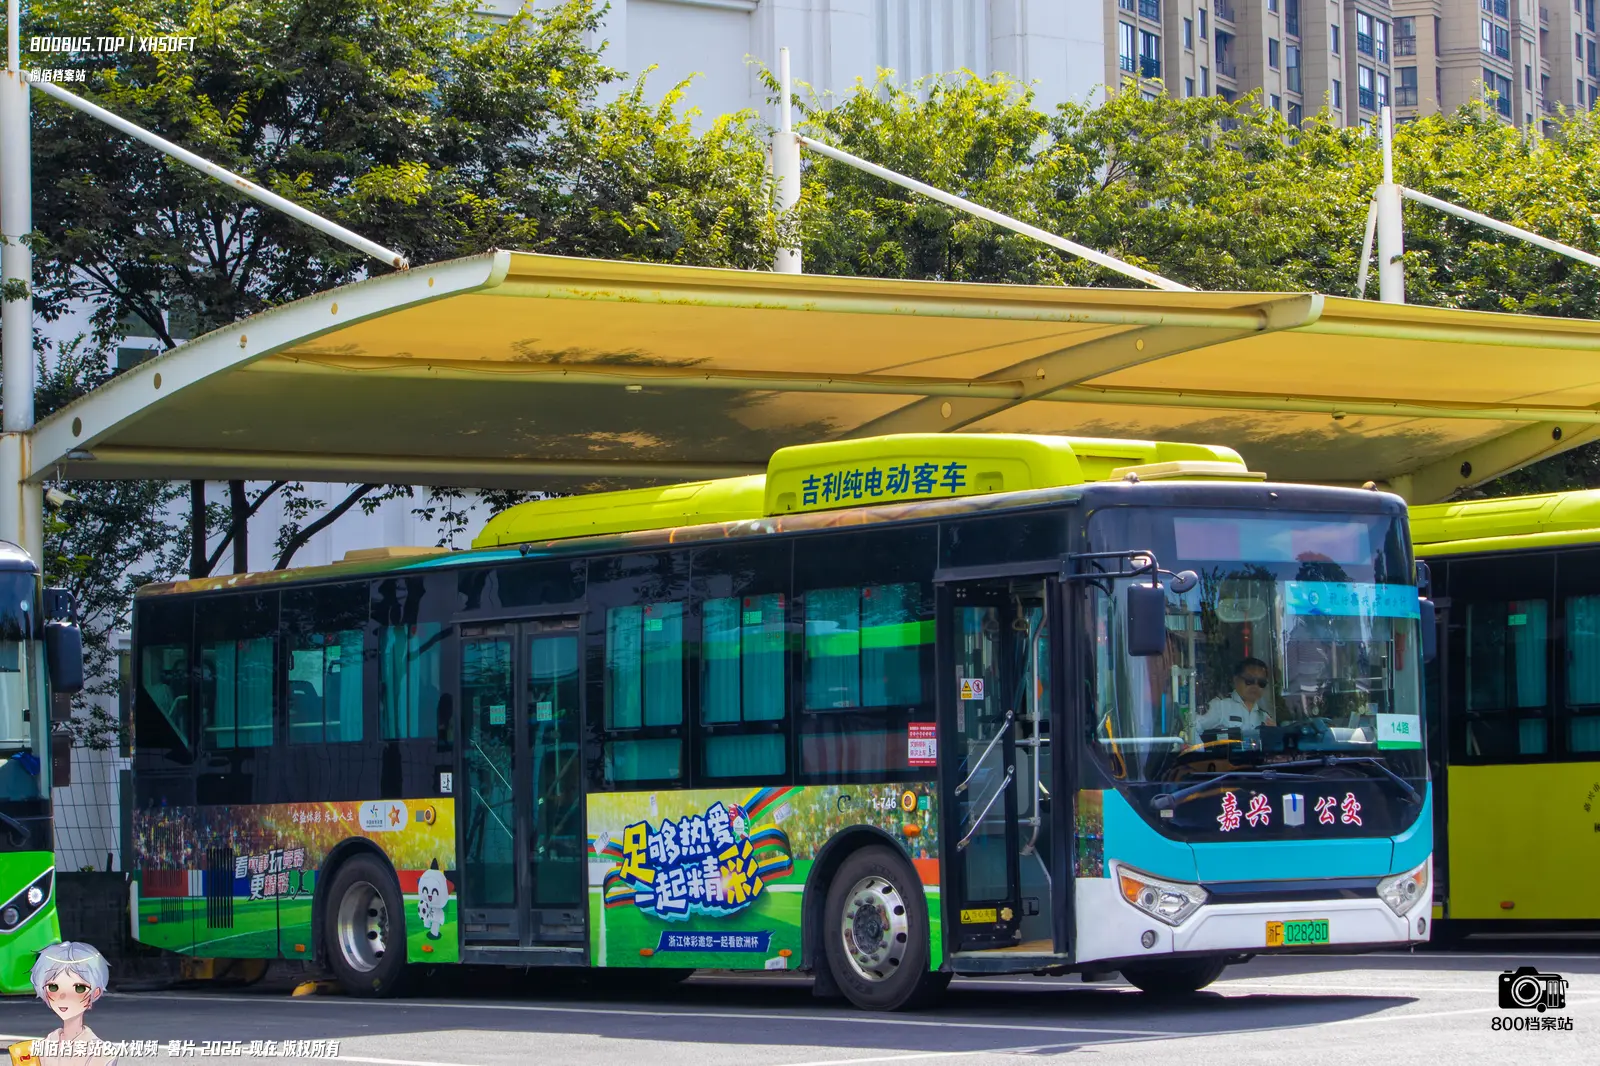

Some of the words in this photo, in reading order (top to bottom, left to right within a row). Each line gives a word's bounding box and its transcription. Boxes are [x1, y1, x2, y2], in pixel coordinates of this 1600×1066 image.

[802, 462, 967, 505] 吉利纯电动客车
[1217, 792, 1272, 832] 嘉兴
[1314, 792, 1363, 826] 公交
[619, 803, 734, 884] 足够热爱
[635, 839, 763, 910] 一起精彩
[668, 935, 759, 948] 浙江体彩邀您一起看欧洲杯
[1287, 923, 1328, 942] 02828D
